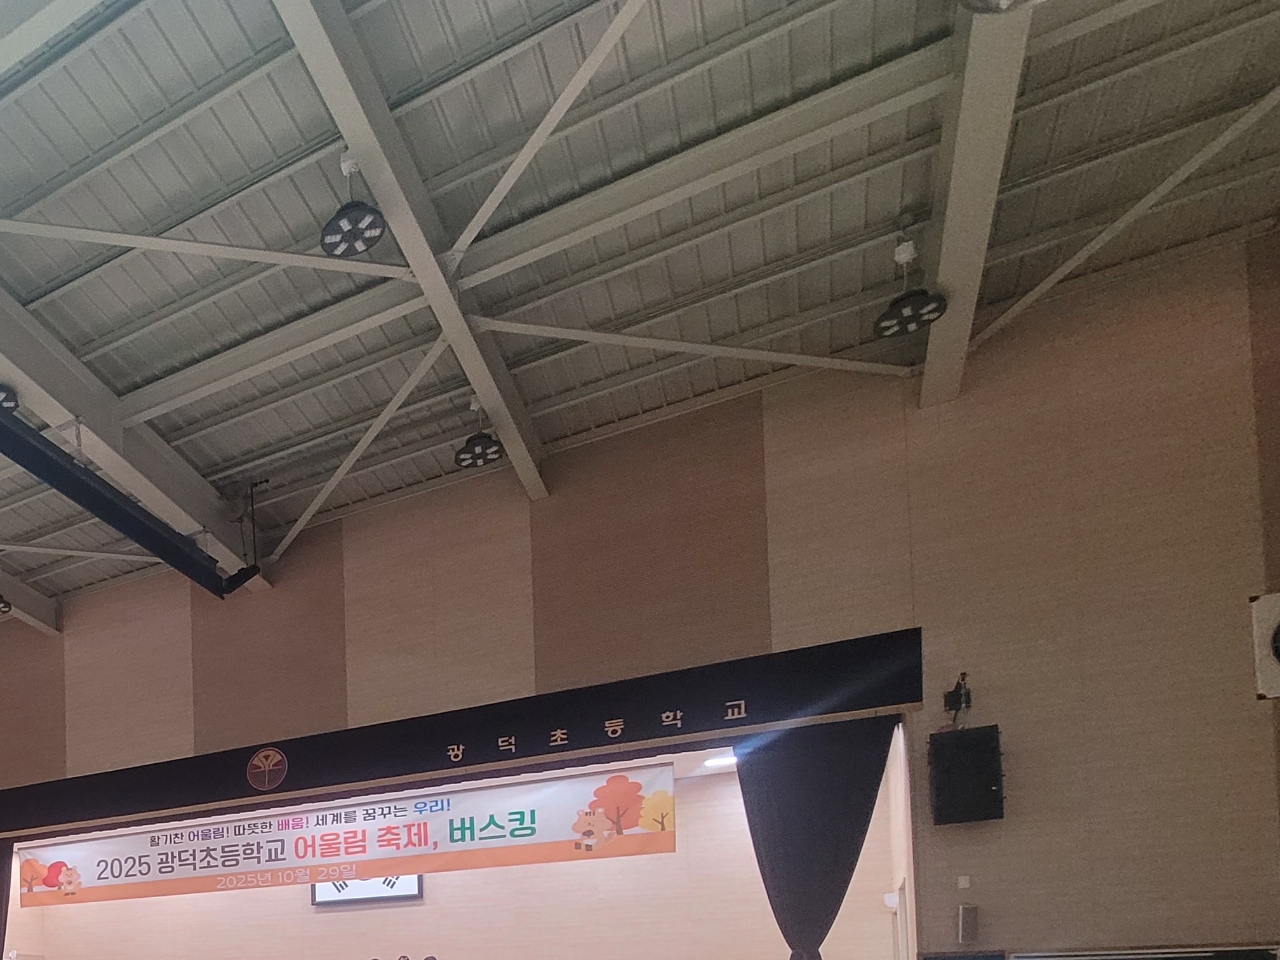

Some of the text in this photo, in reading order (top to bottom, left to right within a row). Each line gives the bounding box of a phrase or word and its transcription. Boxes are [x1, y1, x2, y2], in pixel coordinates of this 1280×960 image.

[96, 809, 537, 881] 2025 광덕초등학교 어울림 축제, 버스킹
[149, 798, 451, 847] 활기찬 어울림! 따뜻한 배움! 세계를 꿈꾸는 우리!
[216, 864, 357, 889] 2025년 10월 29일
